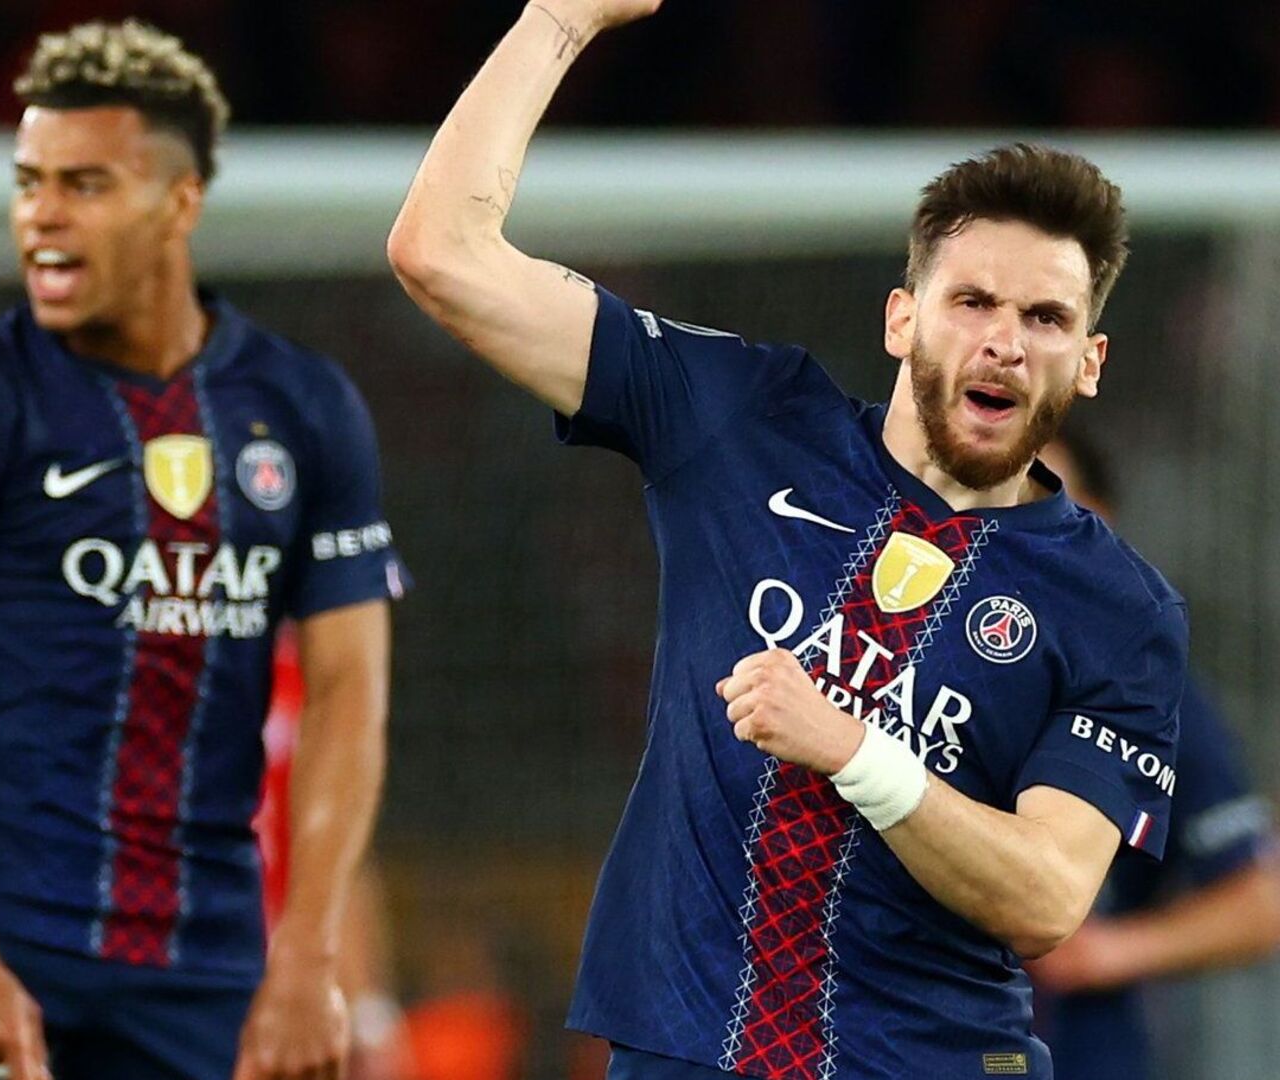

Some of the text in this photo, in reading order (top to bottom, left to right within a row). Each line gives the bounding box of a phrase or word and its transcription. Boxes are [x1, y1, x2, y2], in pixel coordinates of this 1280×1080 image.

[62, 537, 282, 607] QATAR
[990, 599, 1032, 628] PARIS
[748, 578, 972, 746] QATAR
[814, 677, 964, 774] IRWAYS
